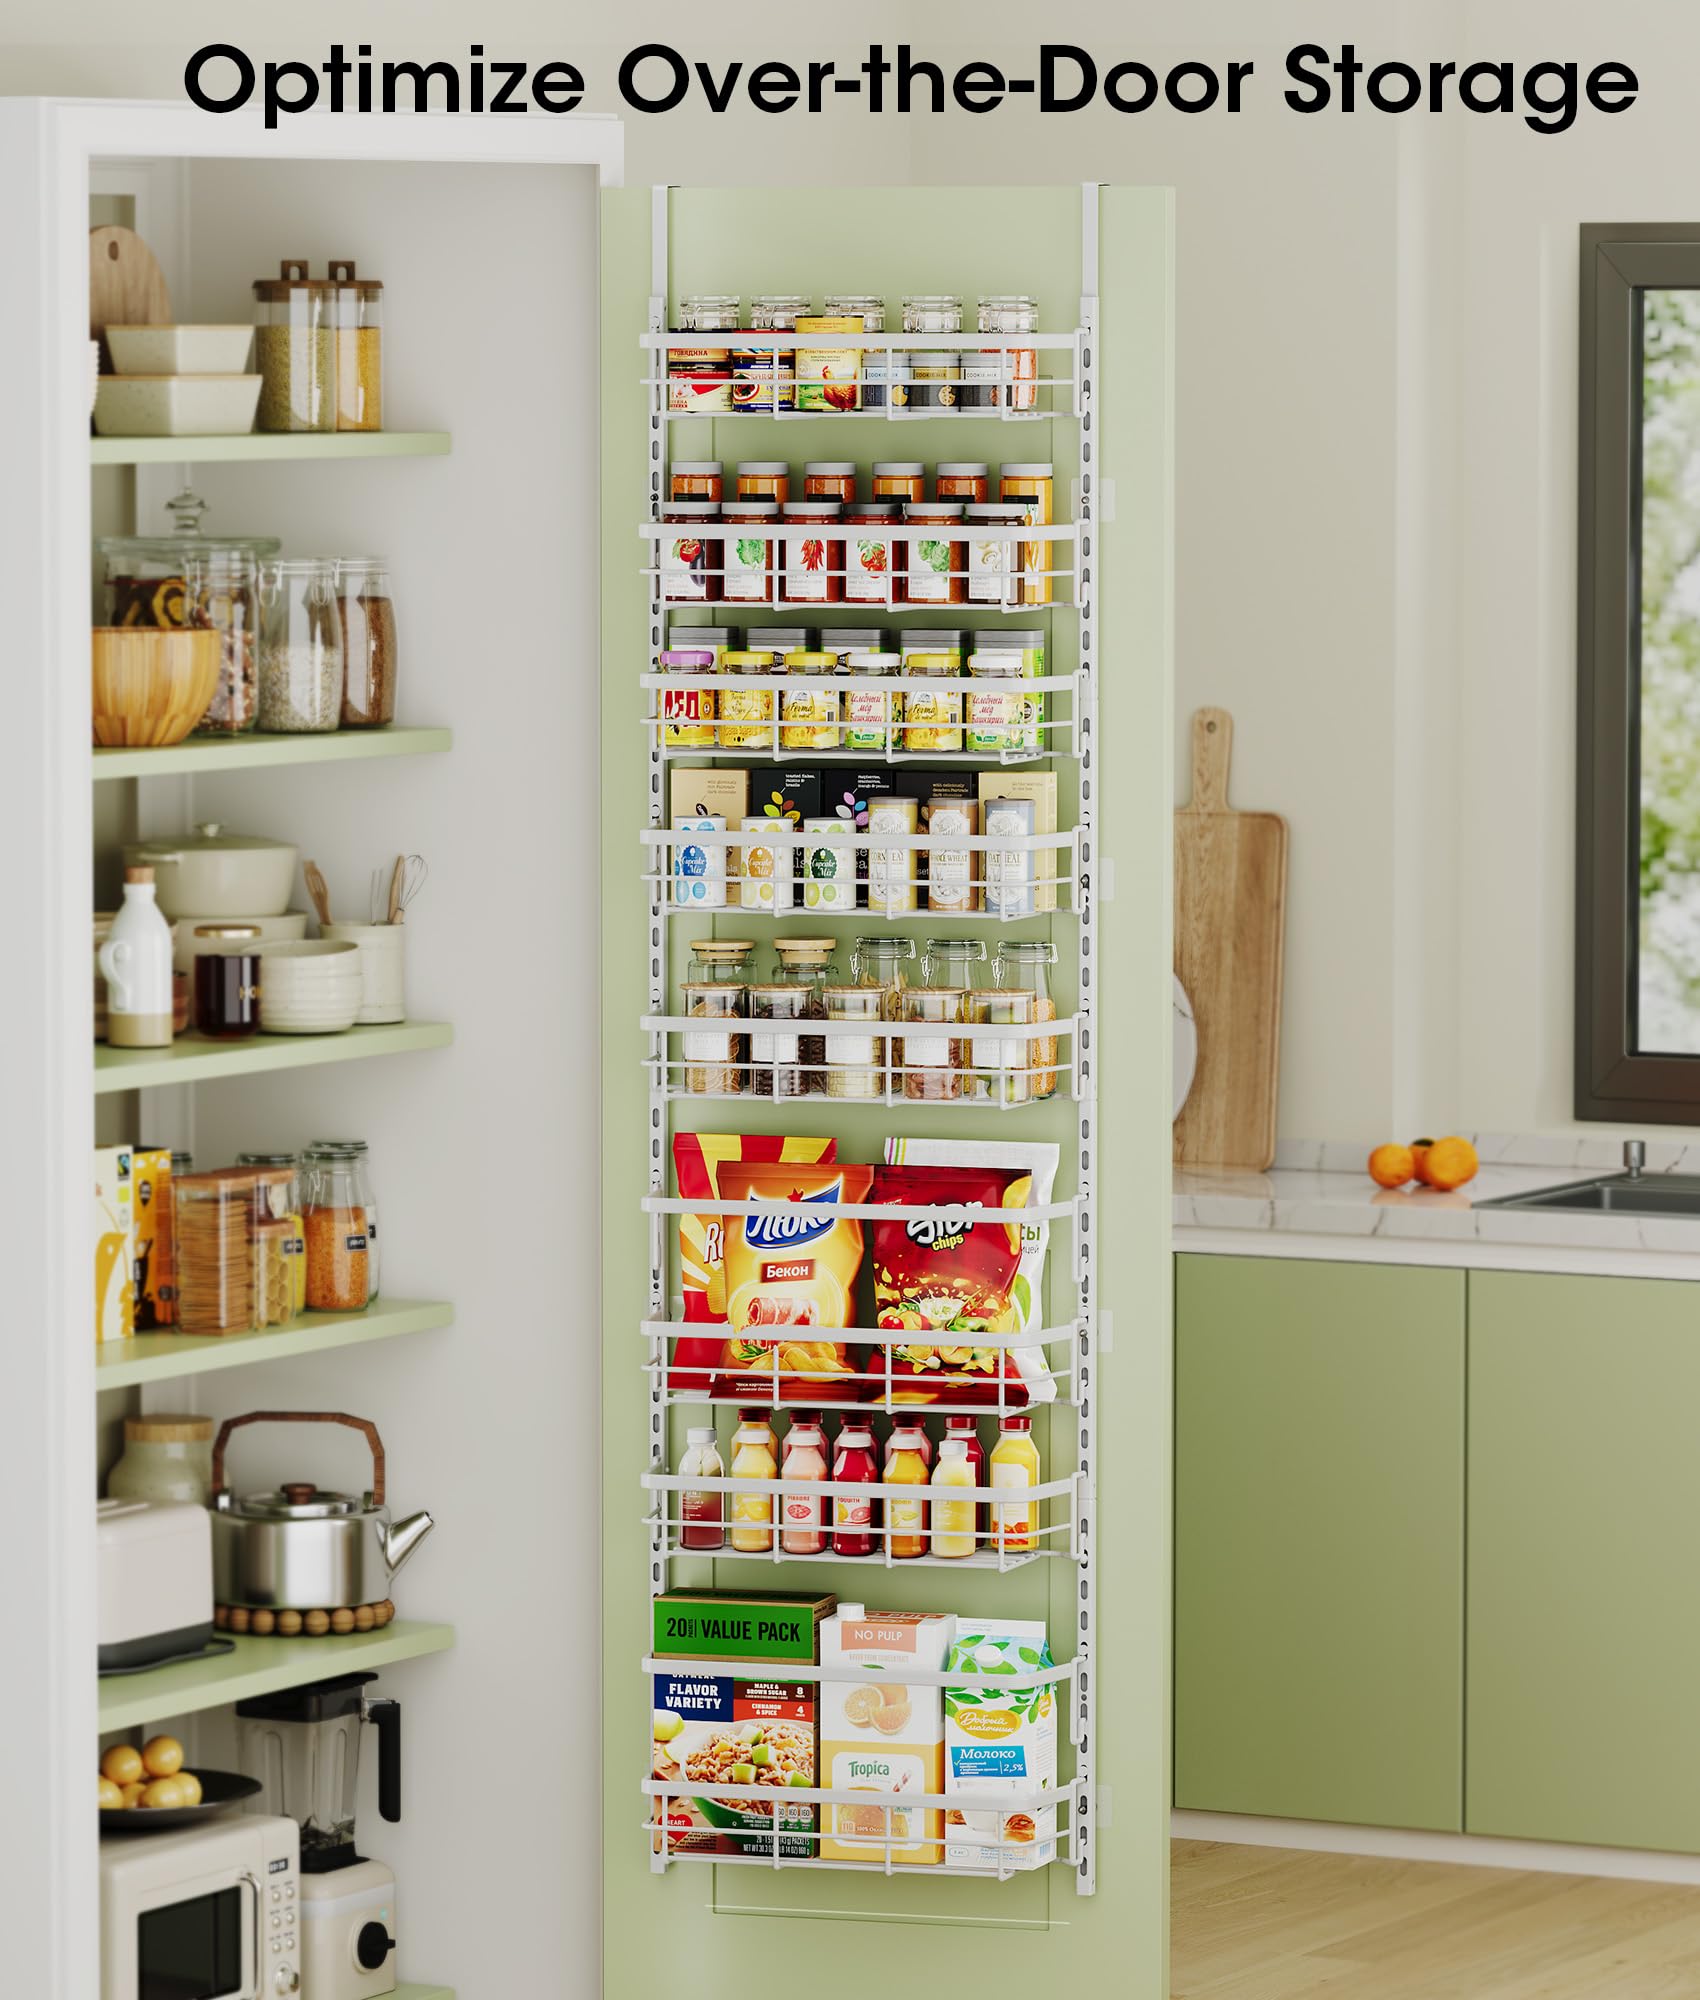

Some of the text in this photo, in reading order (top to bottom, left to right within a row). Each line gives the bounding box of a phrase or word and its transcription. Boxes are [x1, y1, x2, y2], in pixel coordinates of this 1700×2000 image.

[932, 1233, 964, 1251] chips
[766, 1265, 809, 1279] Бекон
[667, 1617, 688, 1638] 20
[700, 1619, 801, 1642] VALUE PACK
[854, 1630, 903, 1641] NO PULP
[669, 1683, 719, 1697] FLAVOR
[796, 1686, 804, 1695] 8
[665, 1696, 722, 1710] VARIETY
[796, 1705, 804, 1714] 4
[960, 1747, 1016, 1759] Молоко
[848, 1760, 890, 1777] Tropica
